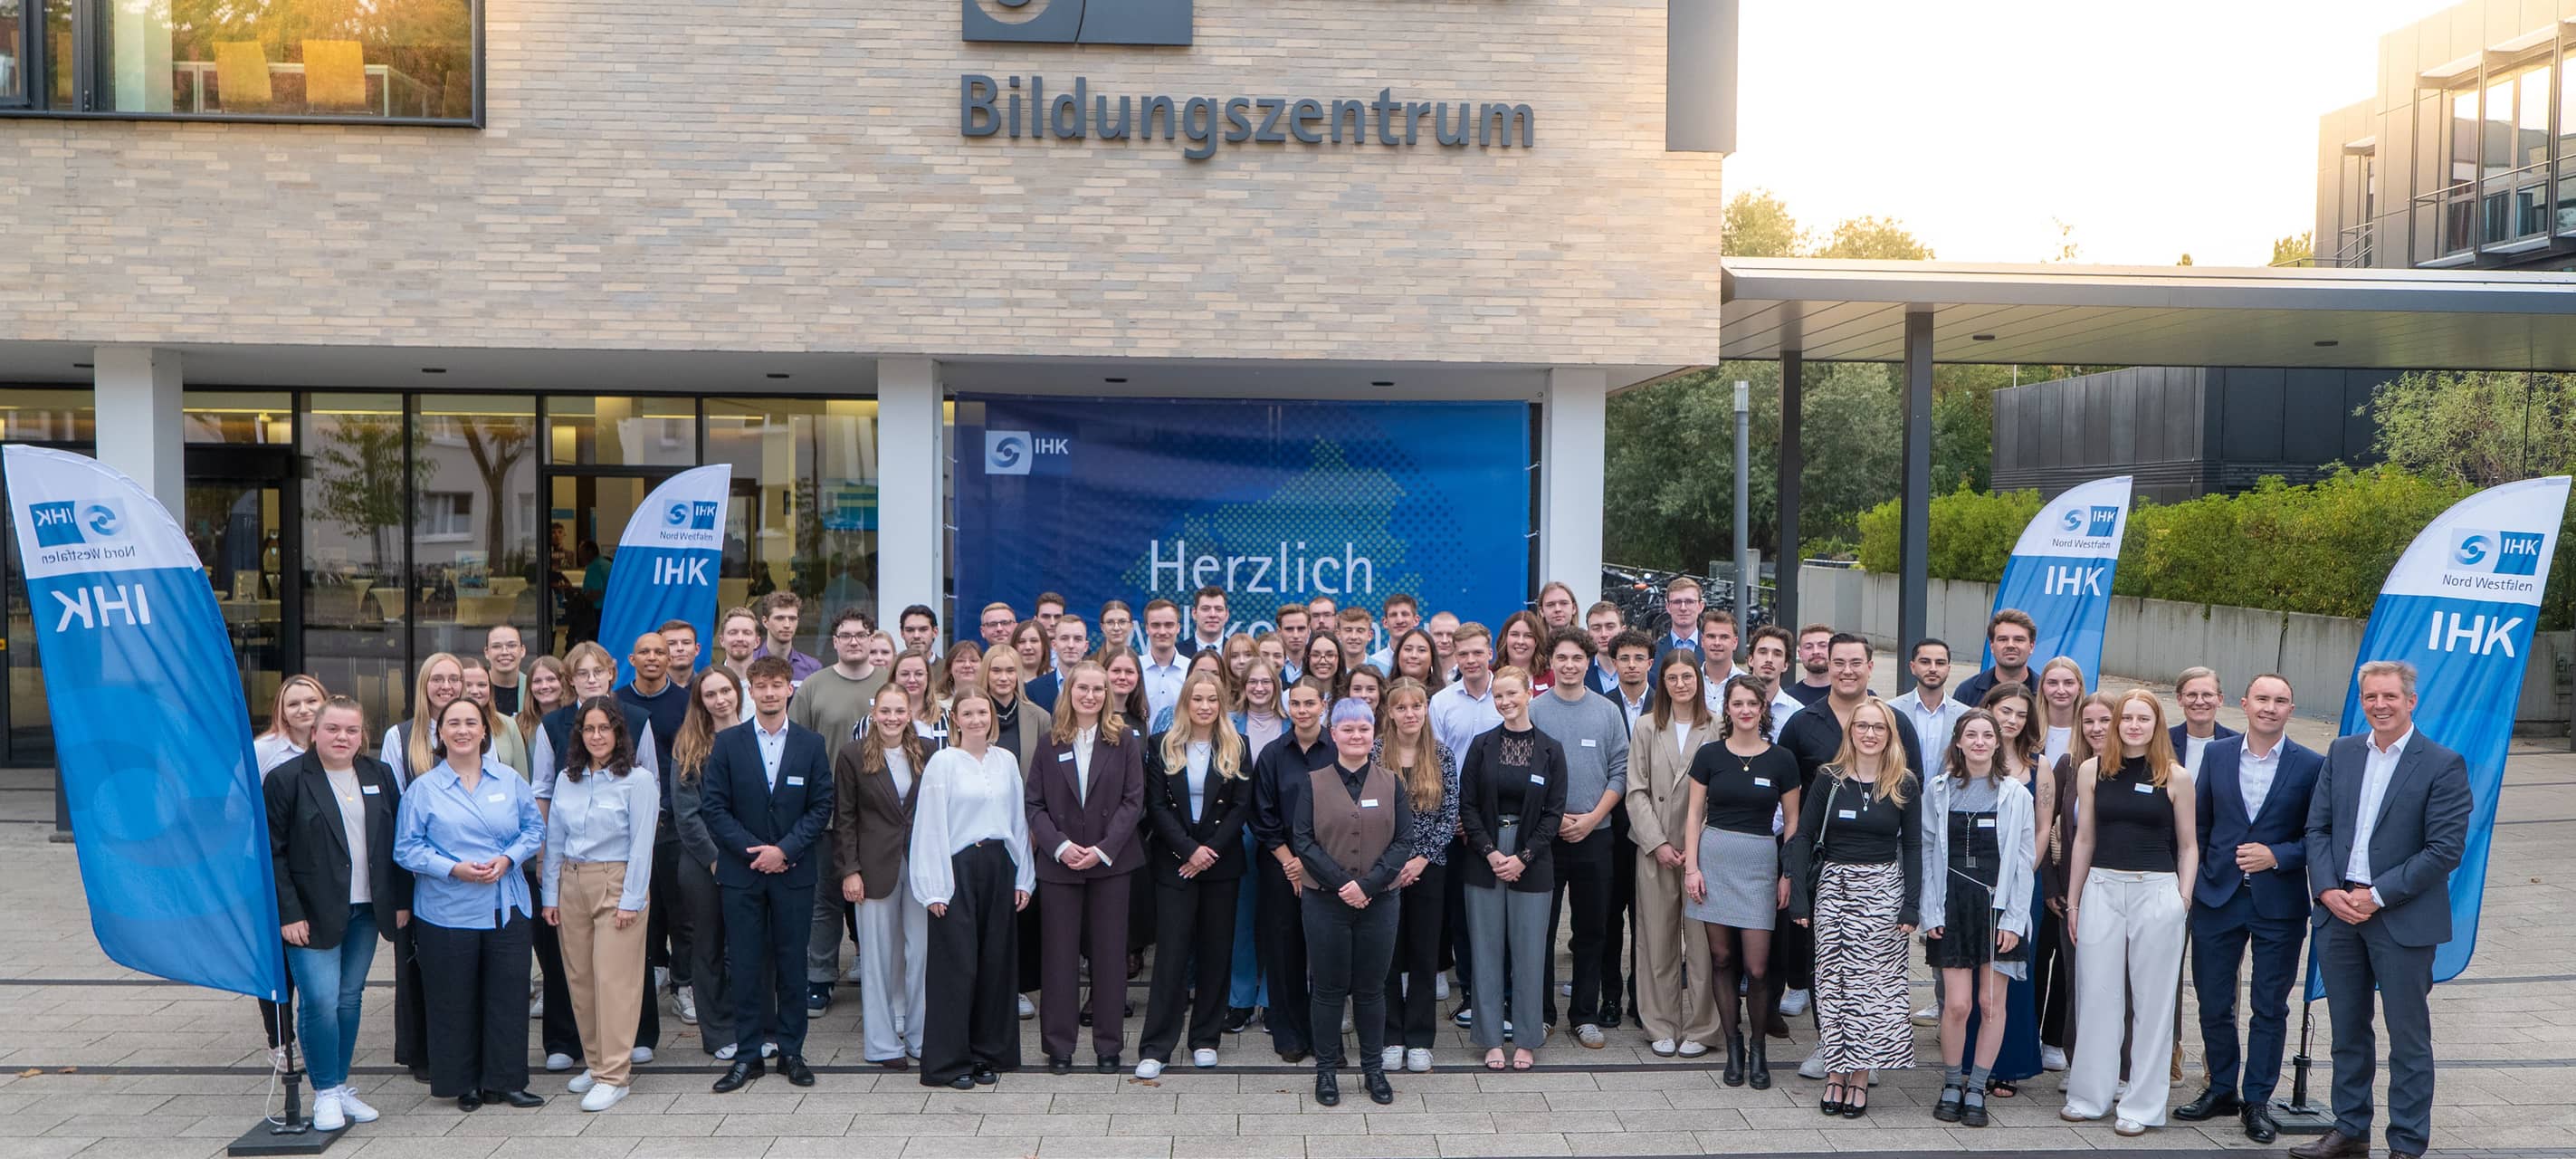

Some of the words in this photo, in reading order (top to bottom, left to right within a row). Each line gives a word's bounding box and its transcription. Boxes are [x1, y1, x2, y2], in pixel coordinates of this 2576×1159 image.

[961, 74, 1534, 160] Bildungszentrum
[1035, 438, 1069, 455] IHK
[695, 505, 716, 517] IHK
[2093, 510, 2116, 522] IHK
[660, 531, 679, 541] Nord
[2052, 538, 2073, 548] Nord
[2504, 538, 2540, 555] IHK
[654, 557, 711, 586] IHK
[1150, 539, 1372, 594] Herzlich
[2045, 565, 2105, 597] IHK
[2442, 574, 2473, 588] Nord
[2428, 610, 2524, 658] IHK
